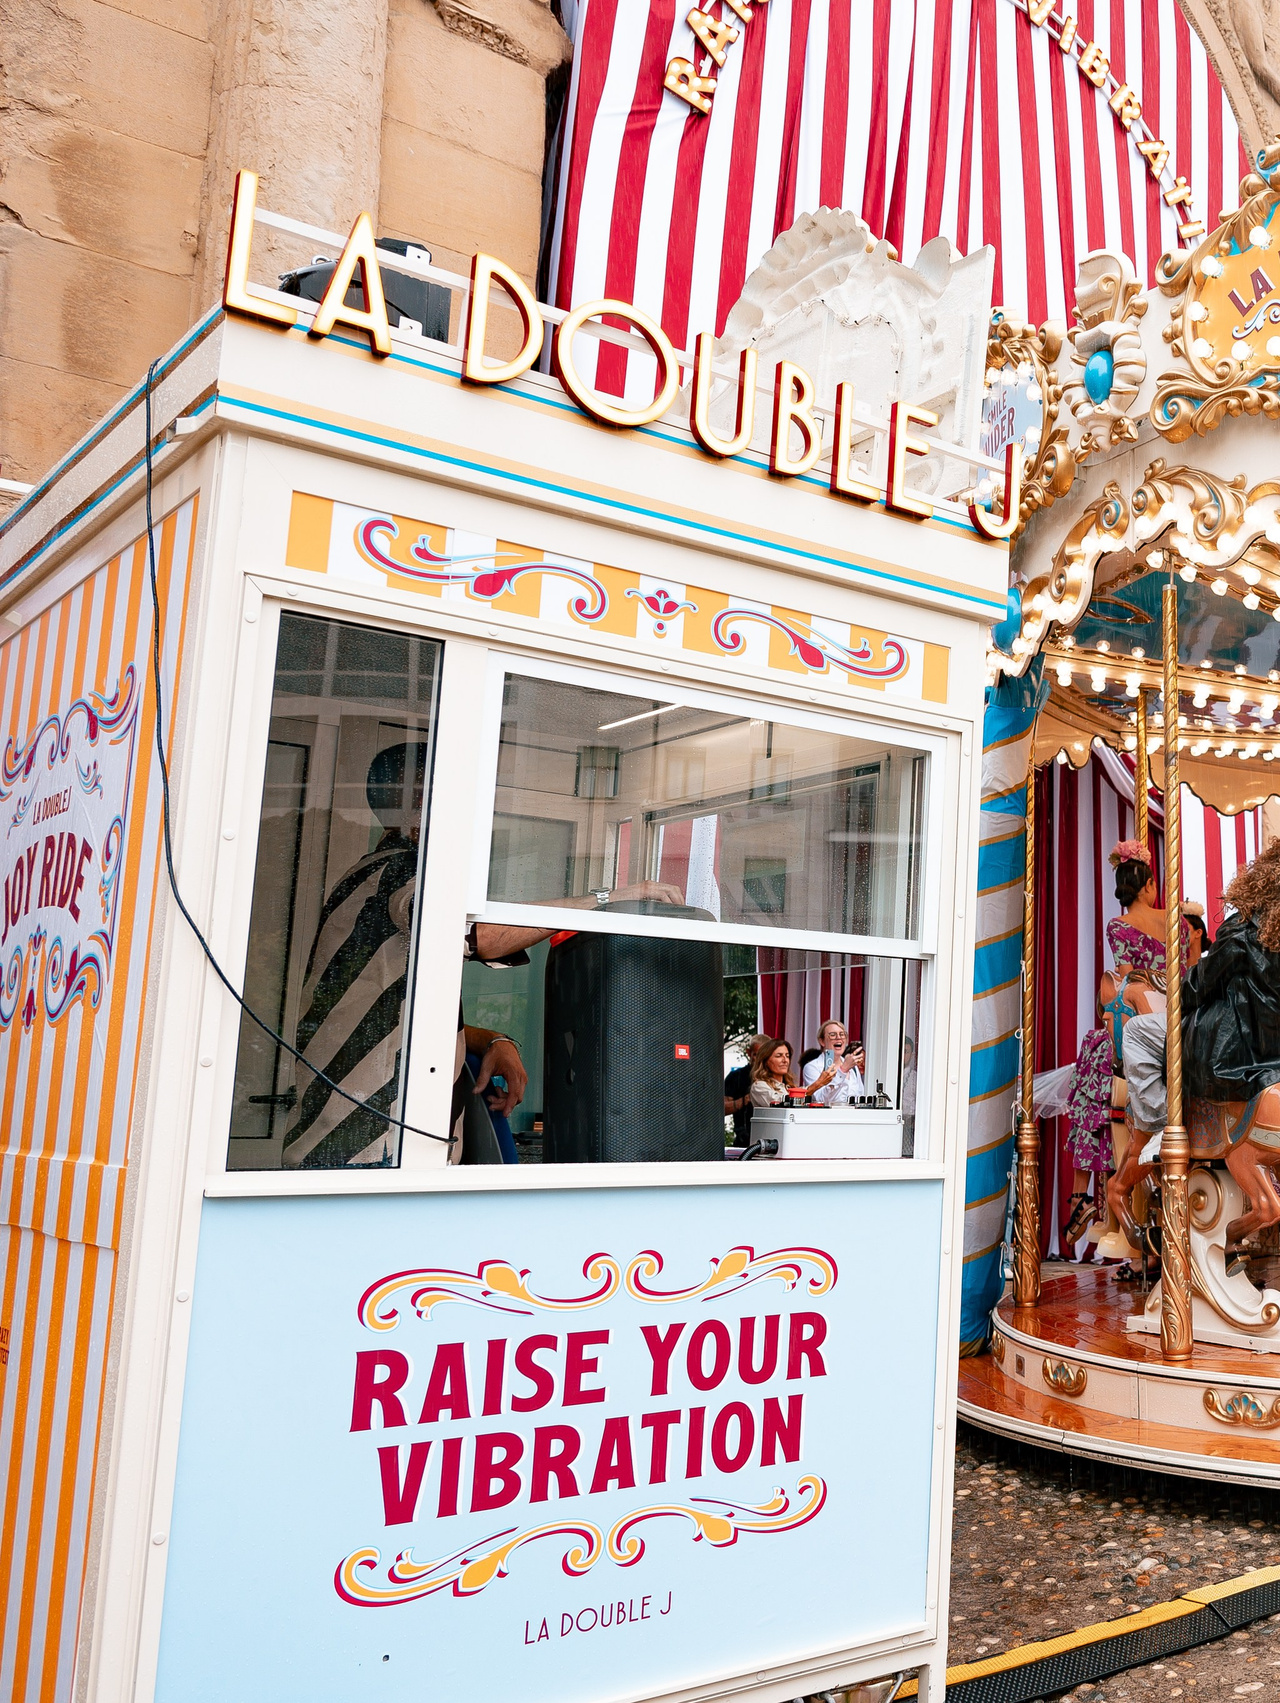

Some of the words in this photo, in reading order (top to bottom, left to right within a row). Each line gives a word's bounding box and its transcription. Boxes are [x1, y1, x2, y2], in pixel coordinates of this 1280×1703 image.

[1228, 266, 1276, 318] LA
[223, 169, 392, 357] LA
[462, 252, 939, 520] DOUBLE
[968, 442, 1022, 540] J
[987, 390, 1007, 425] SMILE
[33, 801, 41, 825] LA
[41, 788, 68, 822] DOUBLE
[66, 785, 72, 812] J
[1, 841, 40, 947] JOY
[37, 832, 94, 925] RIDE
[349, 1328, 613, 1433] RAISE
[640, 1311, 829, 1398] YOUR
[376, 1393, 805, 1528] VIBRATION
[524, 1616, 550, 1646] LA
[560, 1596, 653, 1637] DOUBLE
[659, 1590, 673, 1616] J
